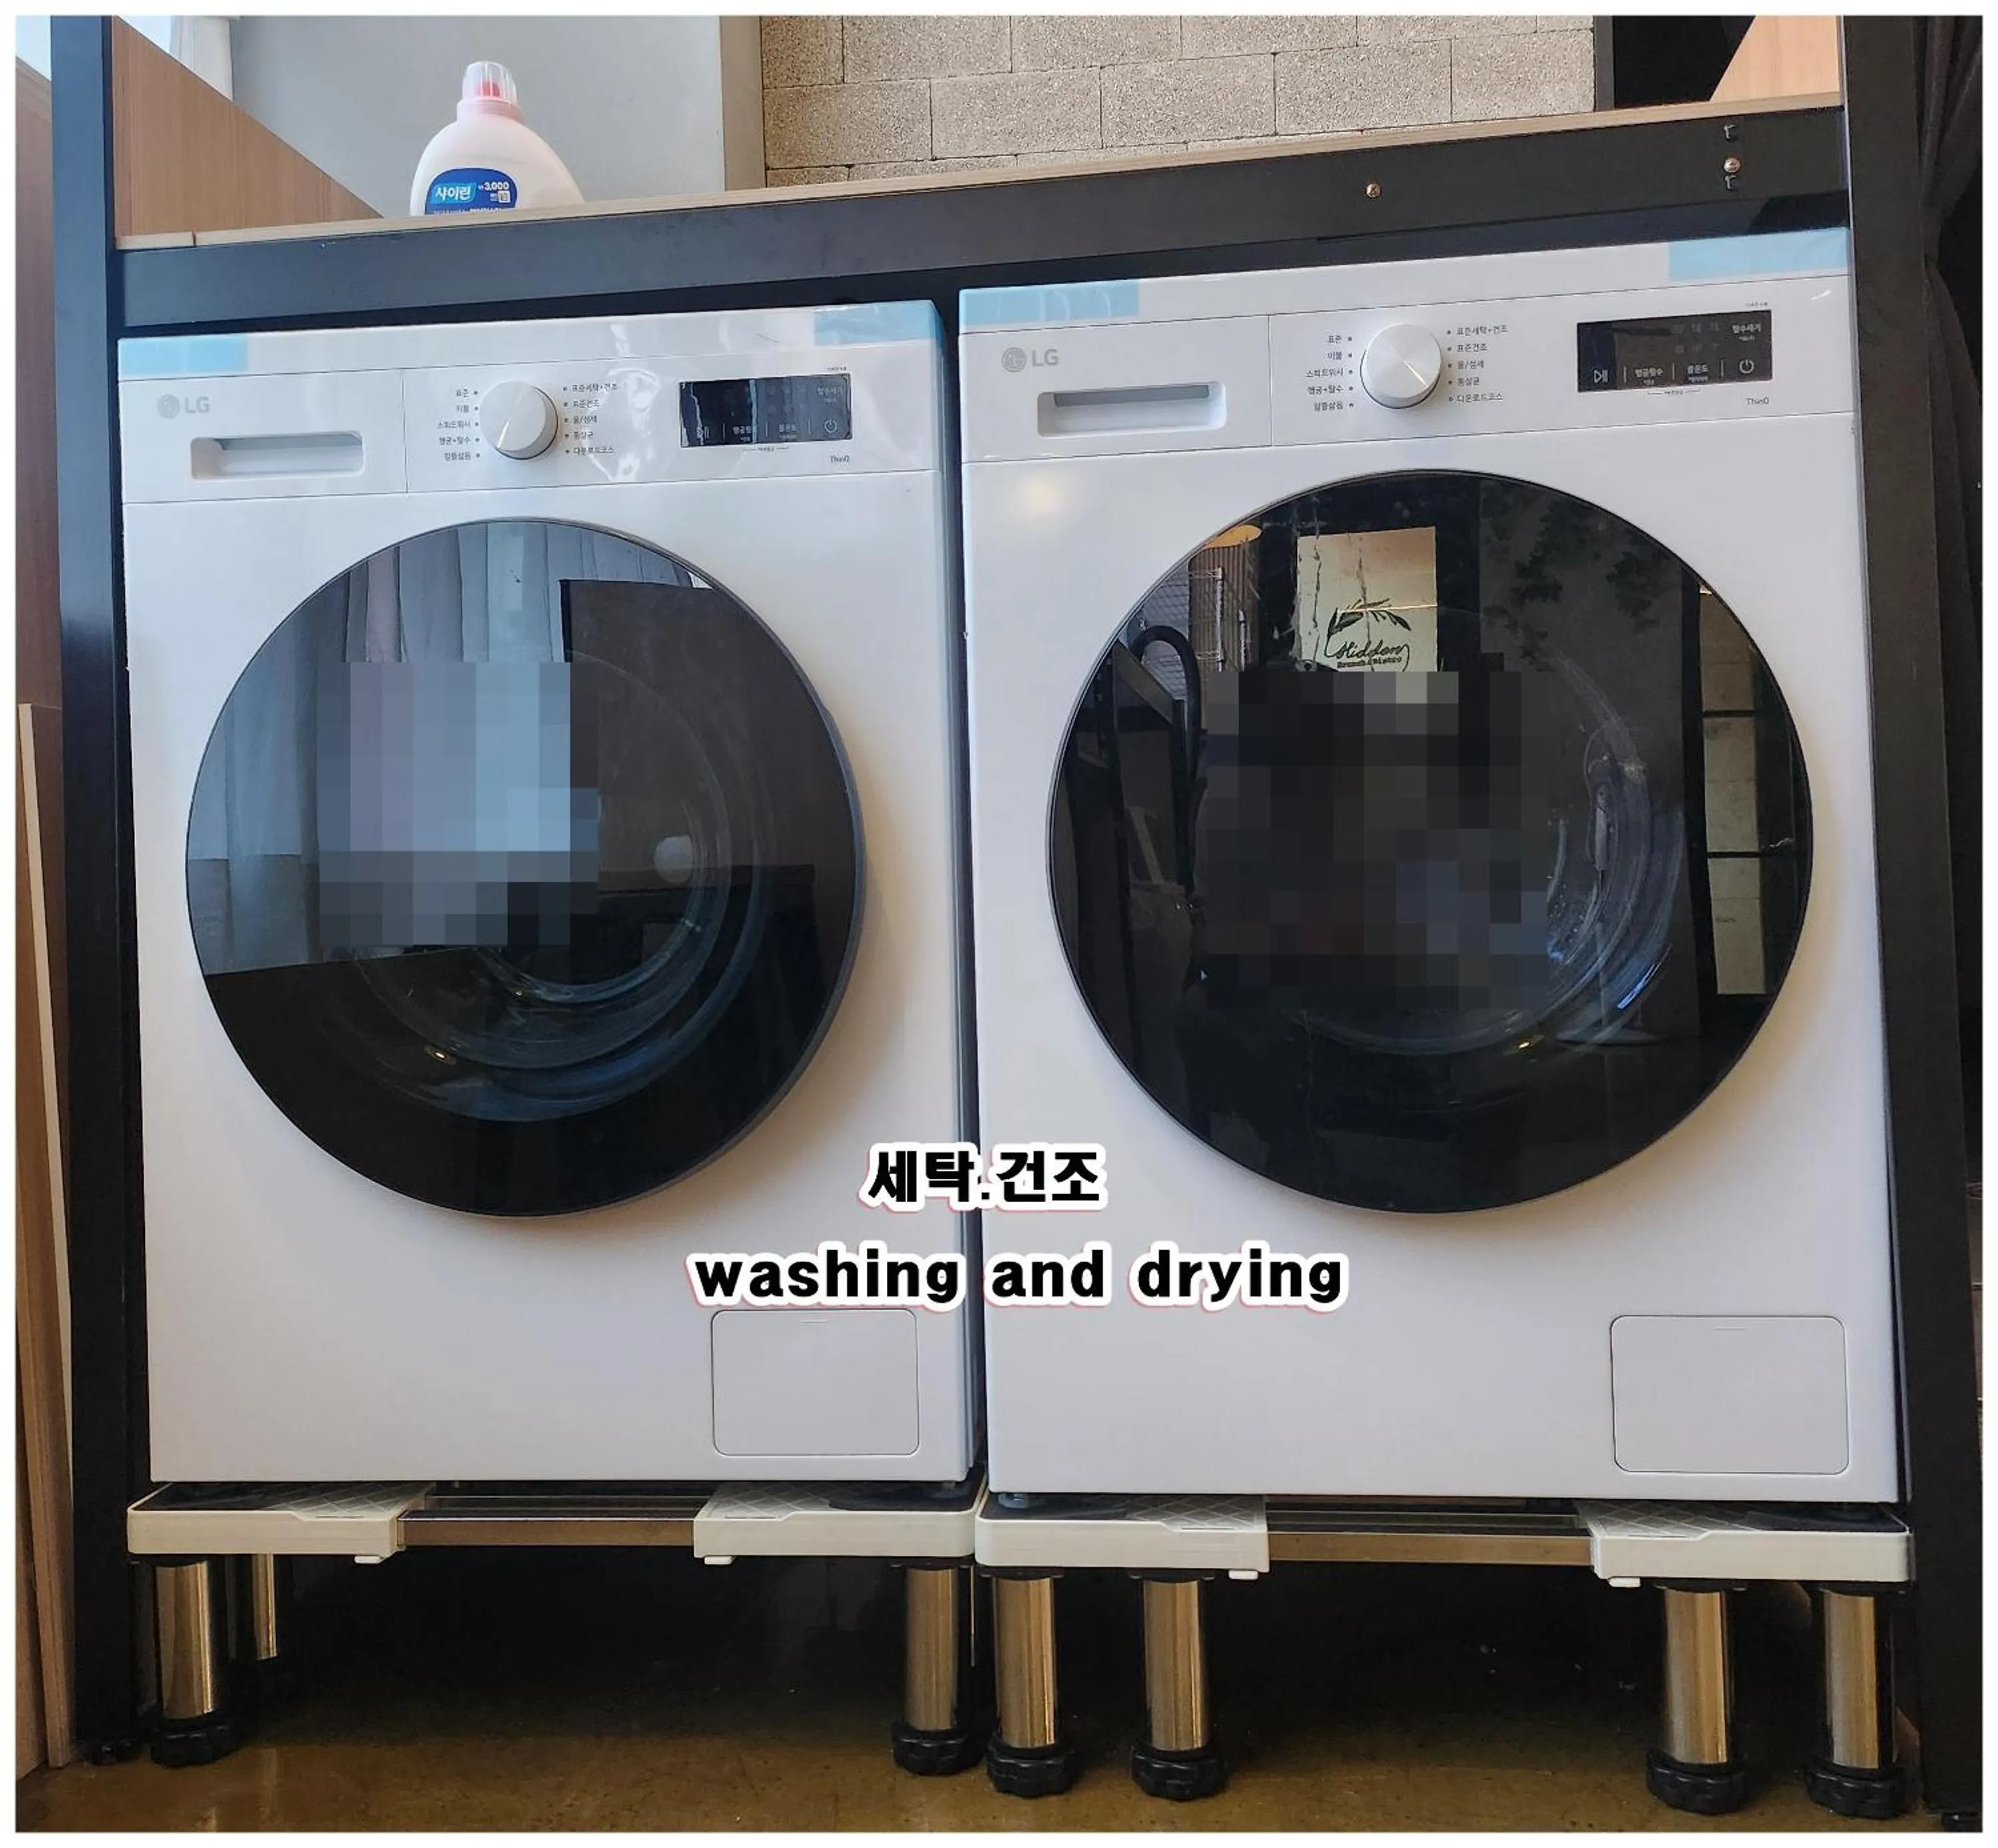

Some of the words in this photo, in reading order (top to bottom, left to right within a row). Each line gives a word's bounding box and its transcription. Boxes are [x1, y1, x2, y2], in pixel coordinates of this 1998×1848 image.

[1456, 325, 1509, 336] 표준세탁+건조
[1328, 335, 1342, 344] 표준
[1456, 343, 1487, 352] 표준건조
[1032, 349, 1058, 367] LG
[1327, 351, 1342, 360] 이불
[1306, 368, 1344, 377] 스피드워시
[1456, 393, 1503, 403] 다운로드코스
[1746, 397, 1770, 405] ThinQ
[185, 395, 211, 413] LG
